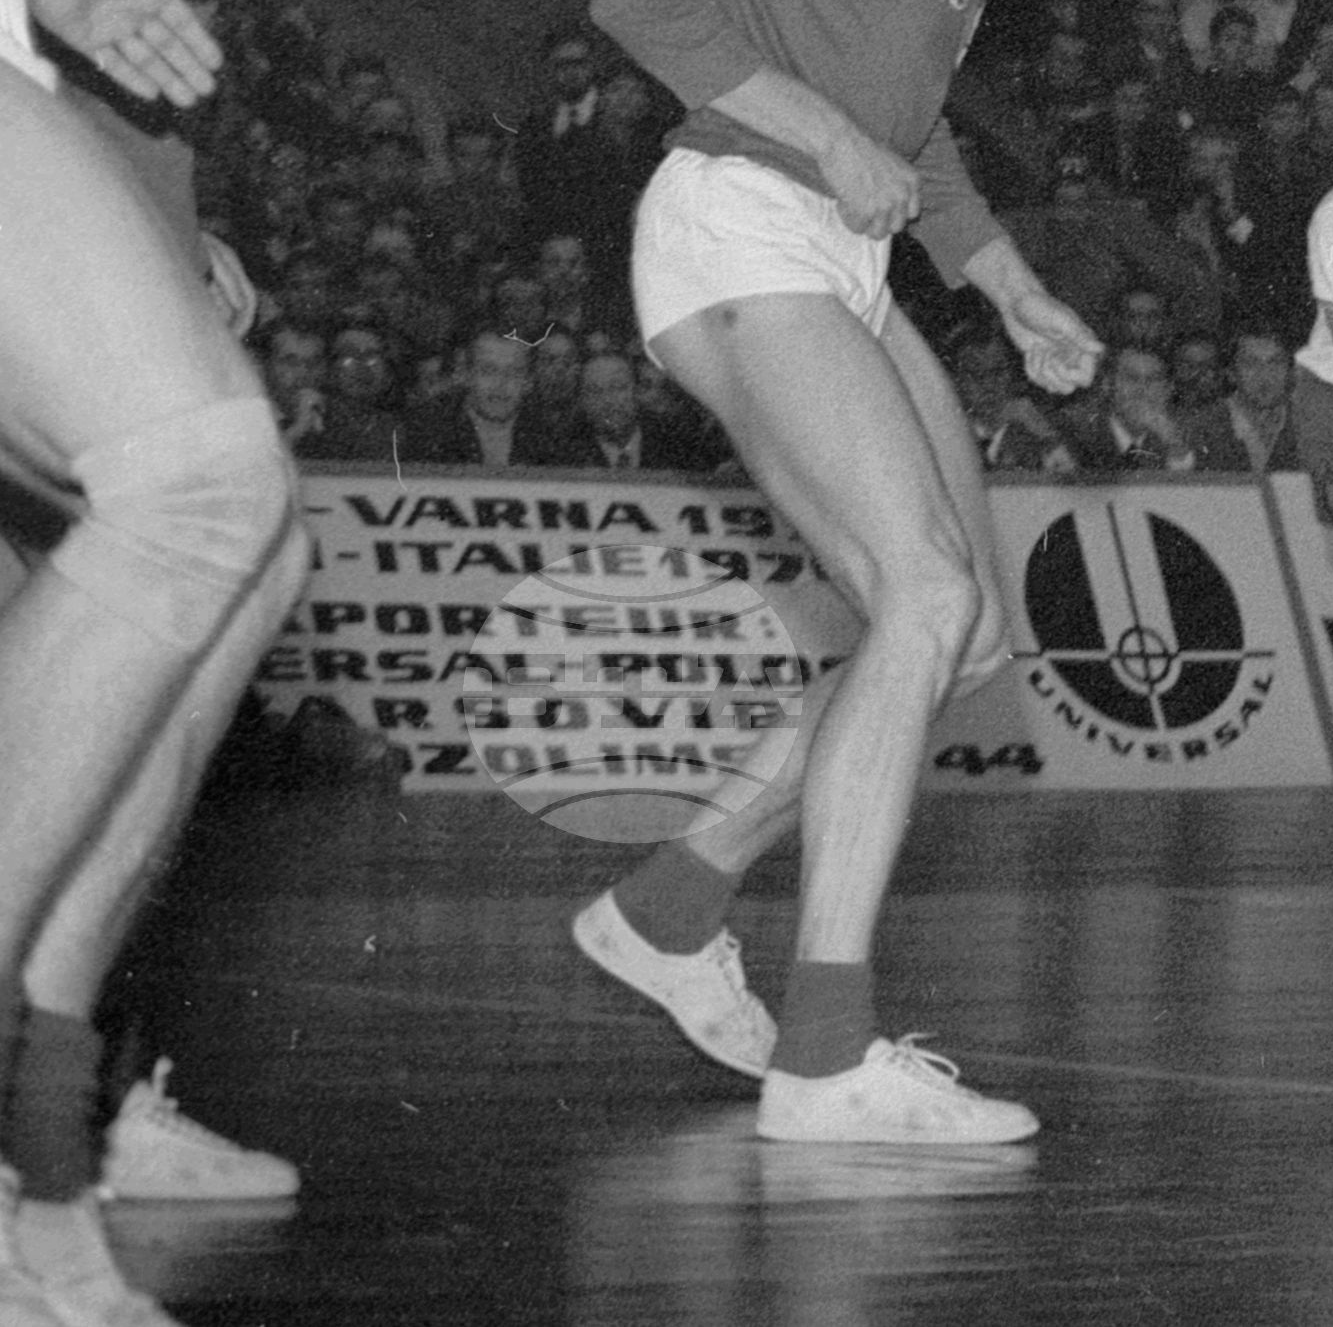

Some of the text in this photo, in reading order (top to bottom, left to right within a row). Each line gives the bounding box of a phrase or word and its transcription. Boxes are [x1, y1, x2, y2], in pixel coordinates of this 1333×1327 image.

[678, 504, 802, 541] 19
[1028, 618, 1274, 765] UNIVERSAL
[935, 743, 1043, 776] 44
